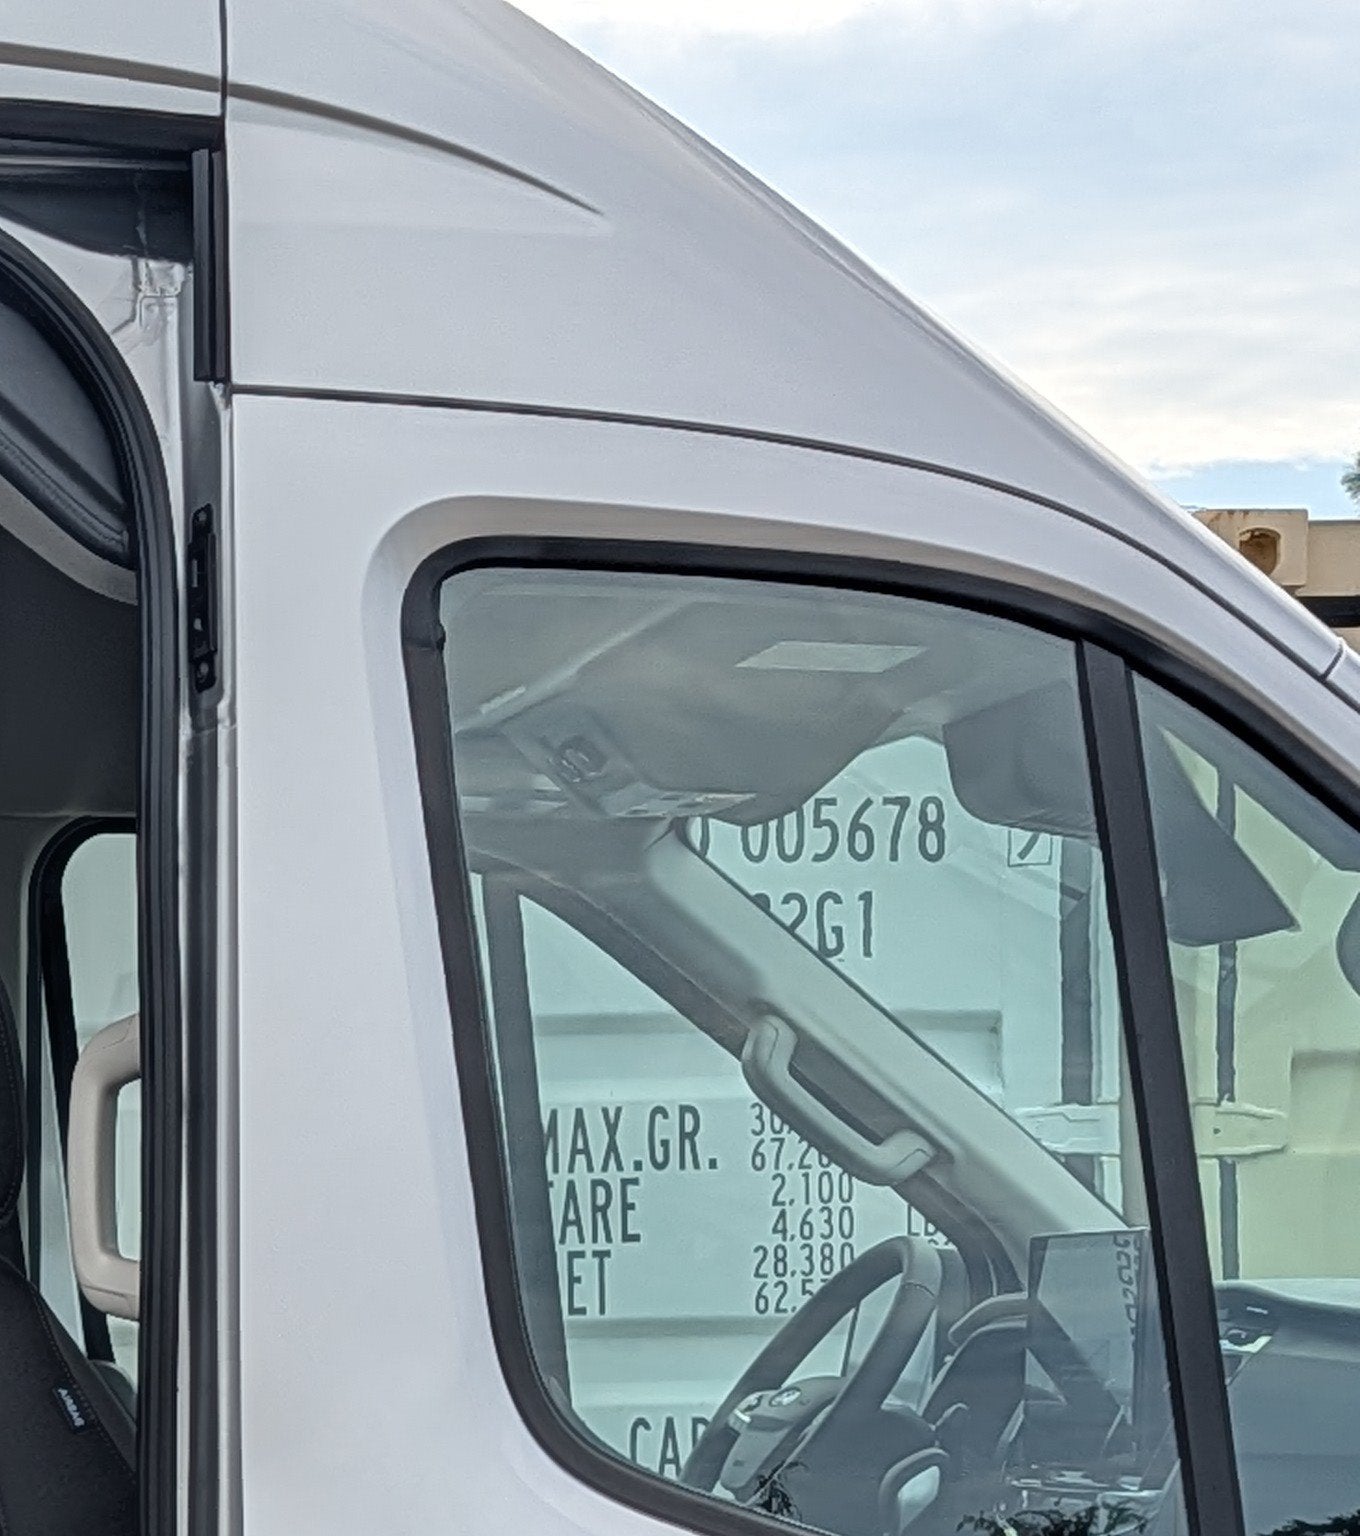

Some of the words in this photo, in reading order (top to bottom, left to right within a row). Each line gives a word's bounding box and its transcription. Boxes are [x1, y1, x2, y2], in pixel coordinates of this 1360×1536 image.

[751, 890, 873, 959] 2G1
[548, 1176, 642, 1245] ARE
[771, 1170, 854, 1207] 2,100
[771, 1205, 855, 1242] 4,630
[566, 1249, 612, 1317] ET
